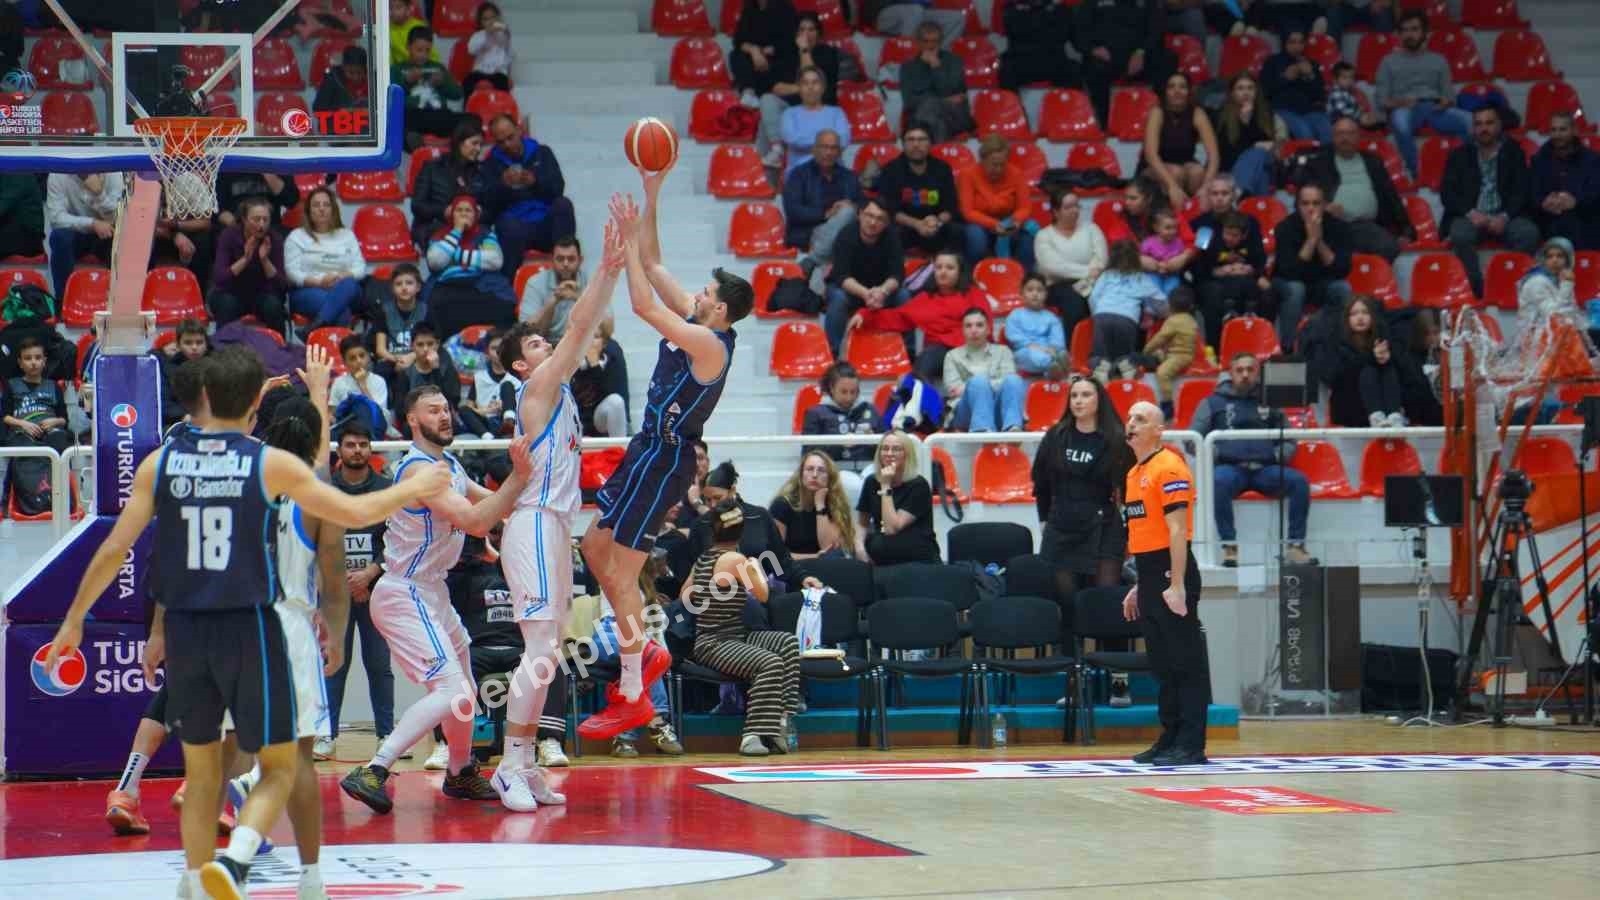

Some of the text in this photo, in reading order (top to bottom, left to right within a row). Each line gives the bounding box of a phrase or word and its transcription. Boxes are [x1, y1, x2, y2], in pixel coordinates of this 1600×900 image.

[314, 111, 369, 134] TBF
[181, 506, 232, 571] 18
[345, 537, 365, 549] TV
[119, 548, 135, 599] ORTA
